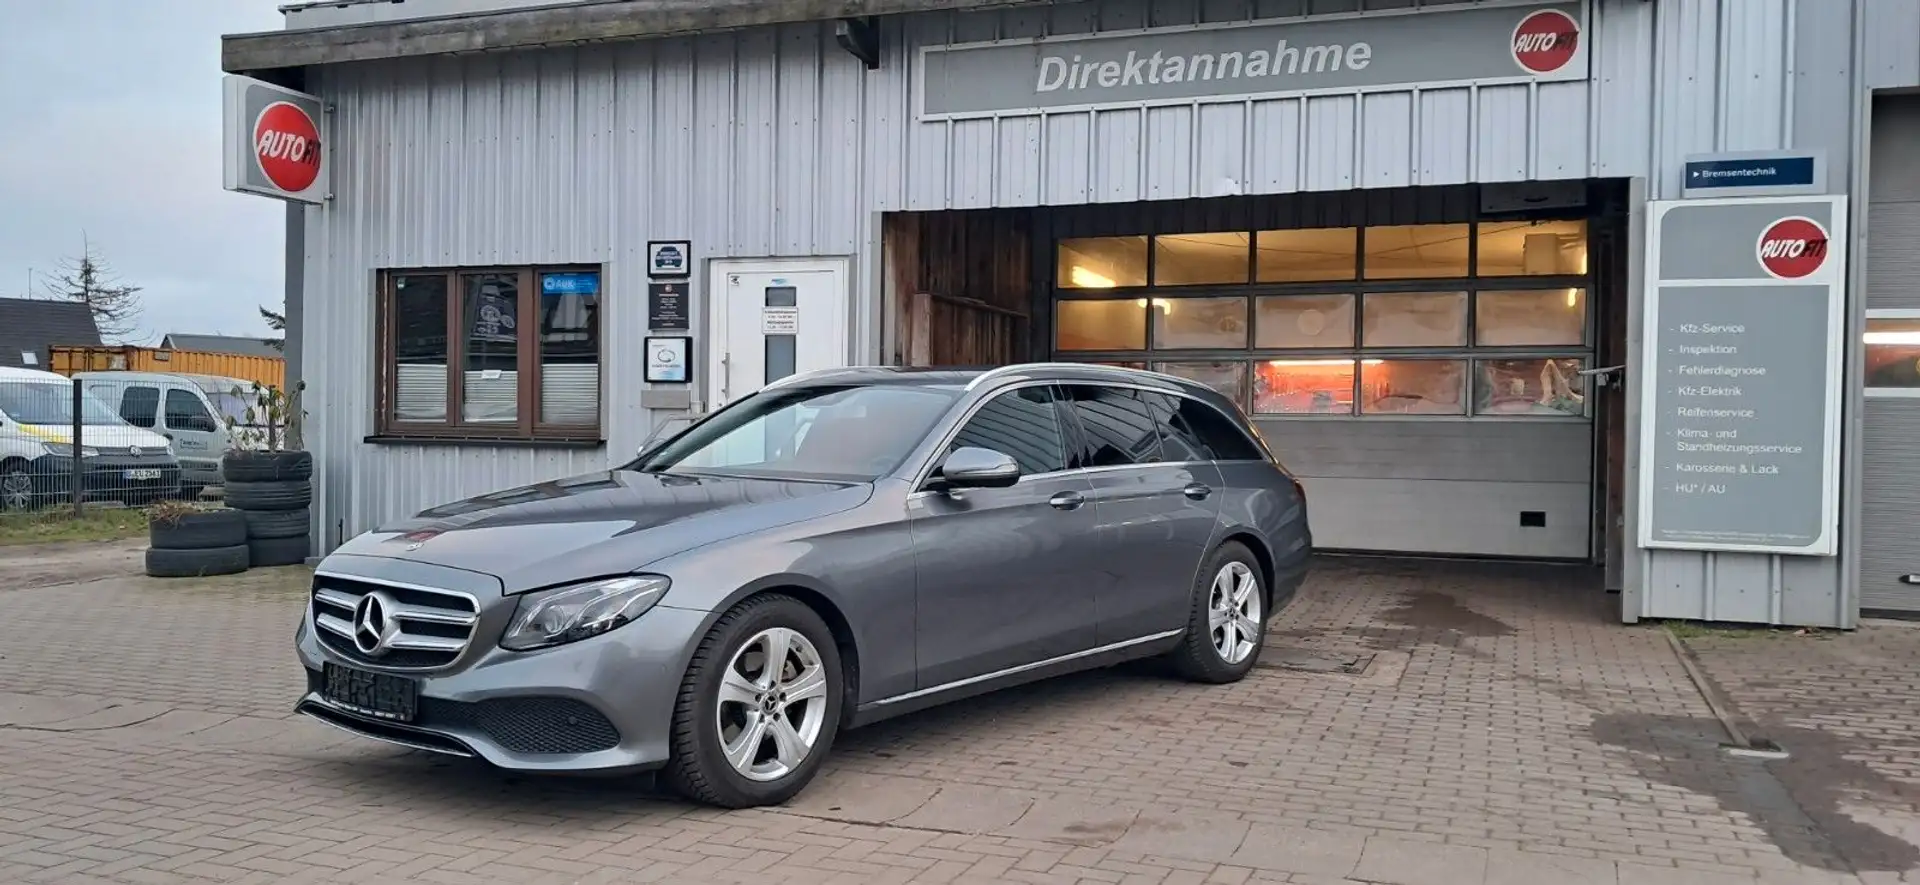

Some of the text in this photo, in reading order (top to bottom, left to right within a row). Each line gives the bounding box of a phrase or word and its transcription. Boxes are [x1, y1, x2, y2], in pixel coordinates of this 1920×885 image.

[1036, 39, 1372, 93] Direktannahme
[1702, 167, 1777, 178] Bremsentechnik
[1761, 238, 1830, 258] AUTOFIT
[1679, 323, 1746, 334] Kfz-Service
[1679, 344, 1738, 356] Inspektion
[1678, 365, 1767, 377] Fehlerdiagnose
[1678, 386, 1743, 396] Kfz-Elektrik
[1677, 407, 1755, 418] Reifenservice
[1677, 428, 1738, 439] Klima- und
[1676, 441, 1802, 455] Standheizungsservice
[1675, 463, 1779, 475] Karosserie & Lack
[1708, 484, 1727, 494] AU
